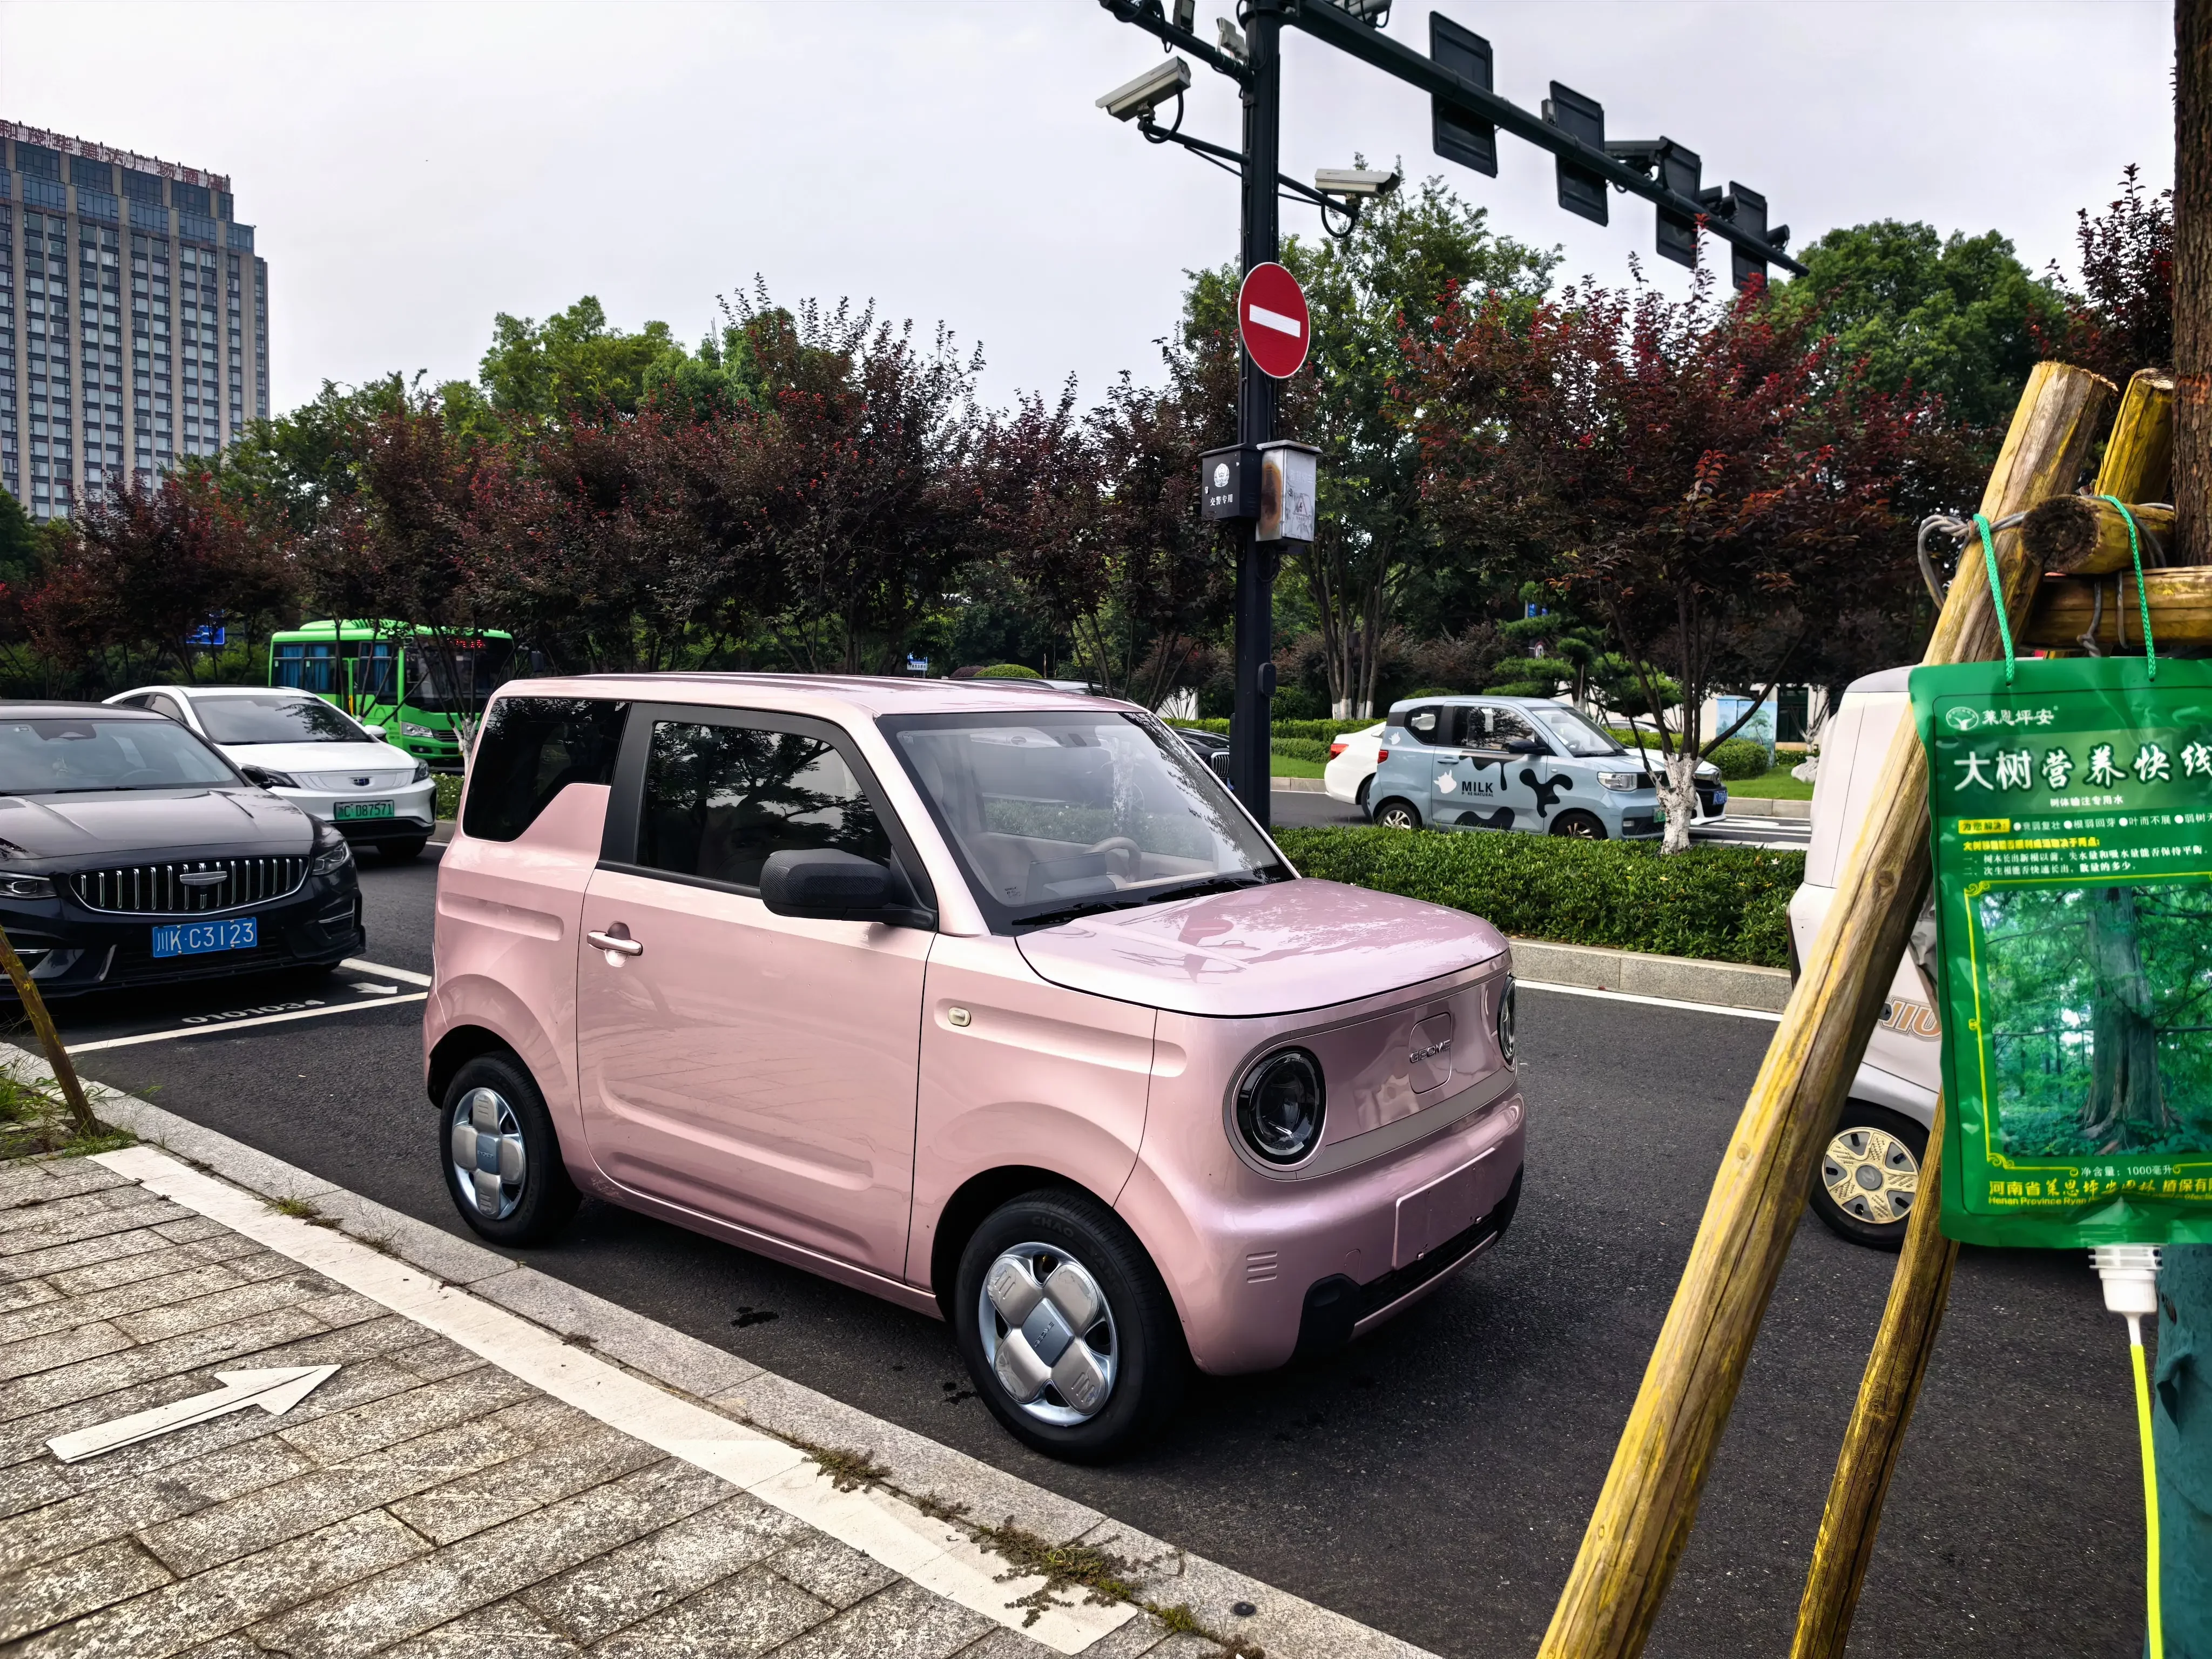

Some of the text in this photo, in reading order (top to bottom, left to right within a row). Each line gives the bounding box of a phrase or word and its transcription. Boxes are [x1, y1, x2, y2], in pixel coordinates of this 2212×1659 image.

[1953, 741, 2212, 791] 大树营养快线
[1462, 781, 1493, 793] MILK
[1988, 1197, 2018, 1205] Henan
[2021, 1197, 2062, 1205] Province
[1032, 1216, 1074, 1238] CHAO
